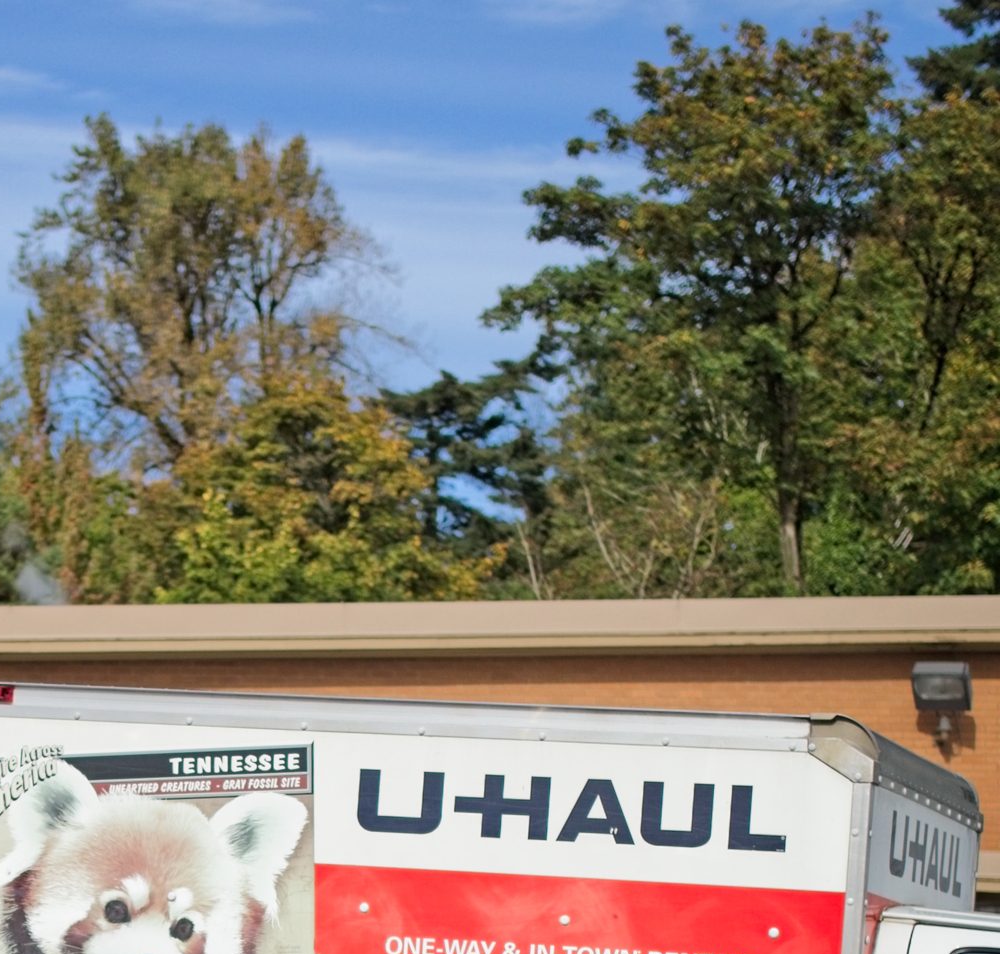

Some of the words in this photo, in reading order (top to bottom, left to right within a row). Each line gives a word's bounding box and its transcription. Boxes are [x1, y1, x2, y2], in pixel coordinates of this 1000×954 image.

[19, 745, 64, 767] Across
[169, 753, 301, 775] TENNESSEE
[160, 780, 211, 792] CREATURES
[222, 778, 247, 791] GRAY
[248, 778, 279, 789] FOSSIL
[280, 776, 301, 788] SITE
[356, 768, 787, 853] U-HAUL
